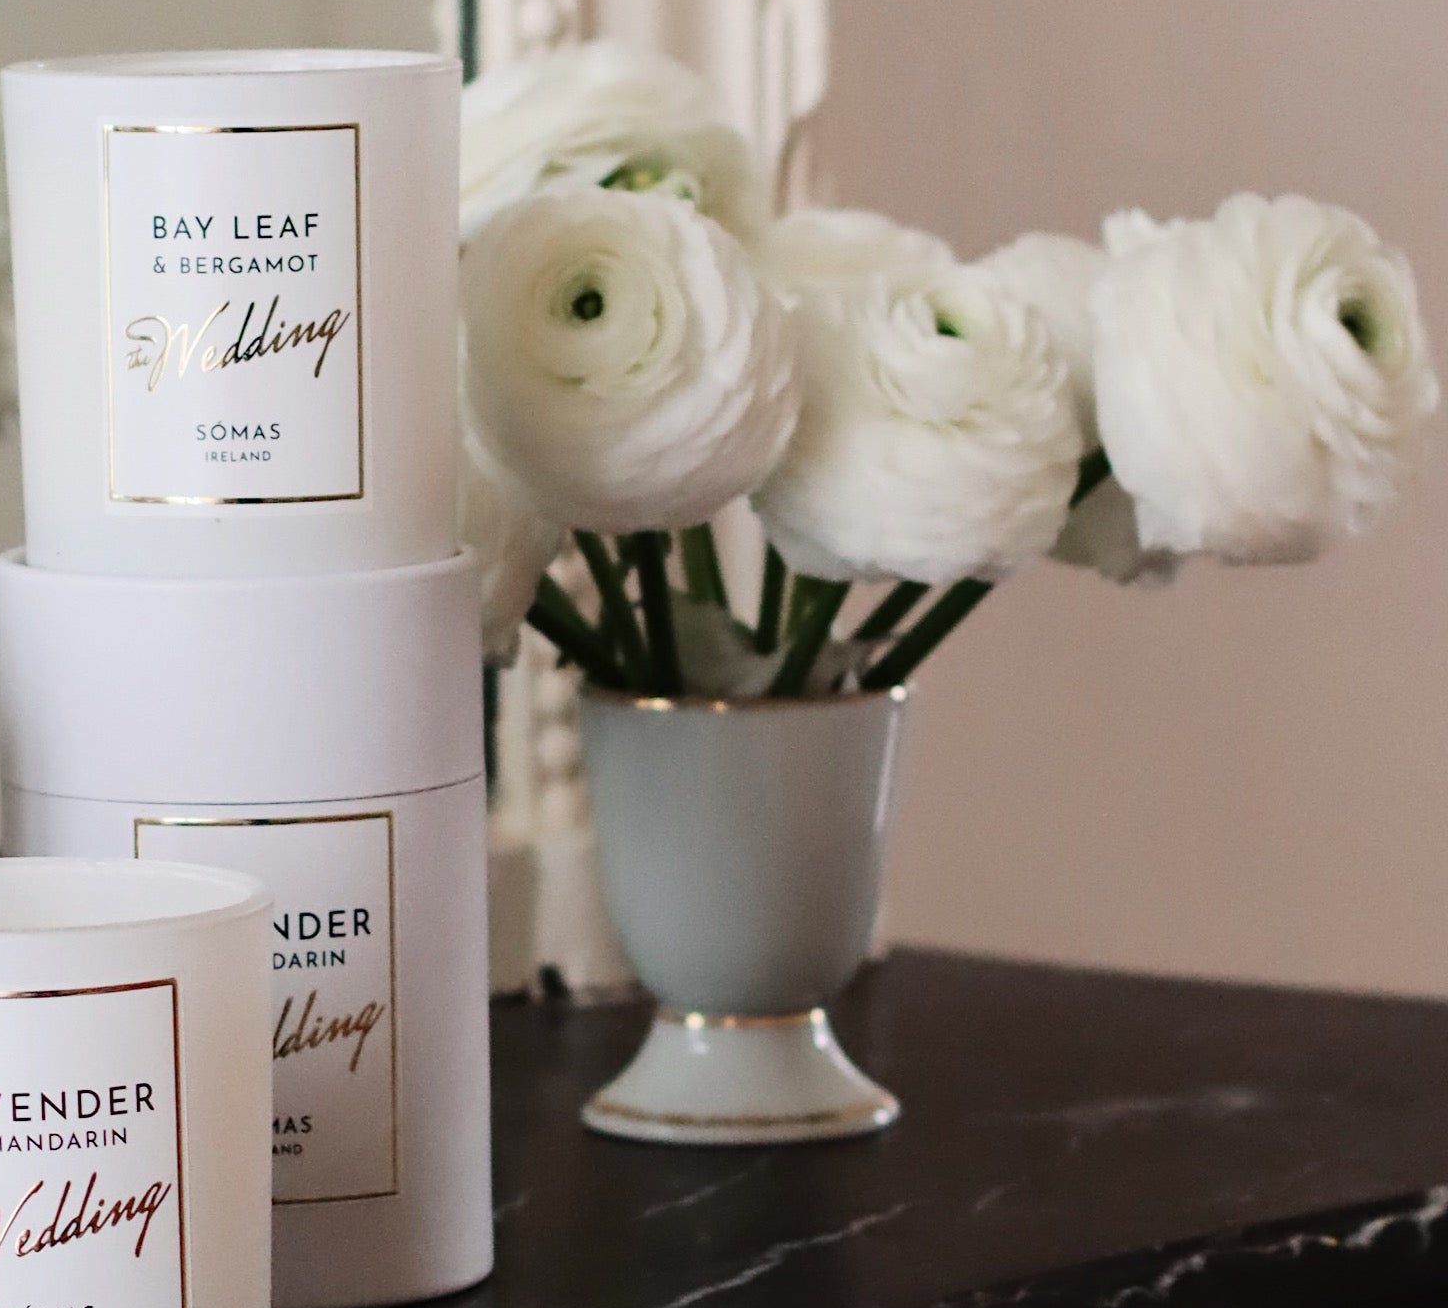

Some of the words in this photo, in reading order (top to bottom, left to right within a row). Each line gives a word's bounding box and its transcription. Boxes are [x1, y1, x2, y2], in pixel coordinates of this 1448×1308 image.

[152, 214, 214, 240] BAY
[233, 212, 320, 240] LEAF
[152, 256, 167, 274] &
[179, 253, 319, 275] BERGAMOT
[125, 294, 351, 393] Wedding
[196, 420, 281, 442] SÓMAS
[205, 449, 272, 463] IRELAND
[273, 908, 371, 941] NDER
[273, 949, 346, 971] DARIN
